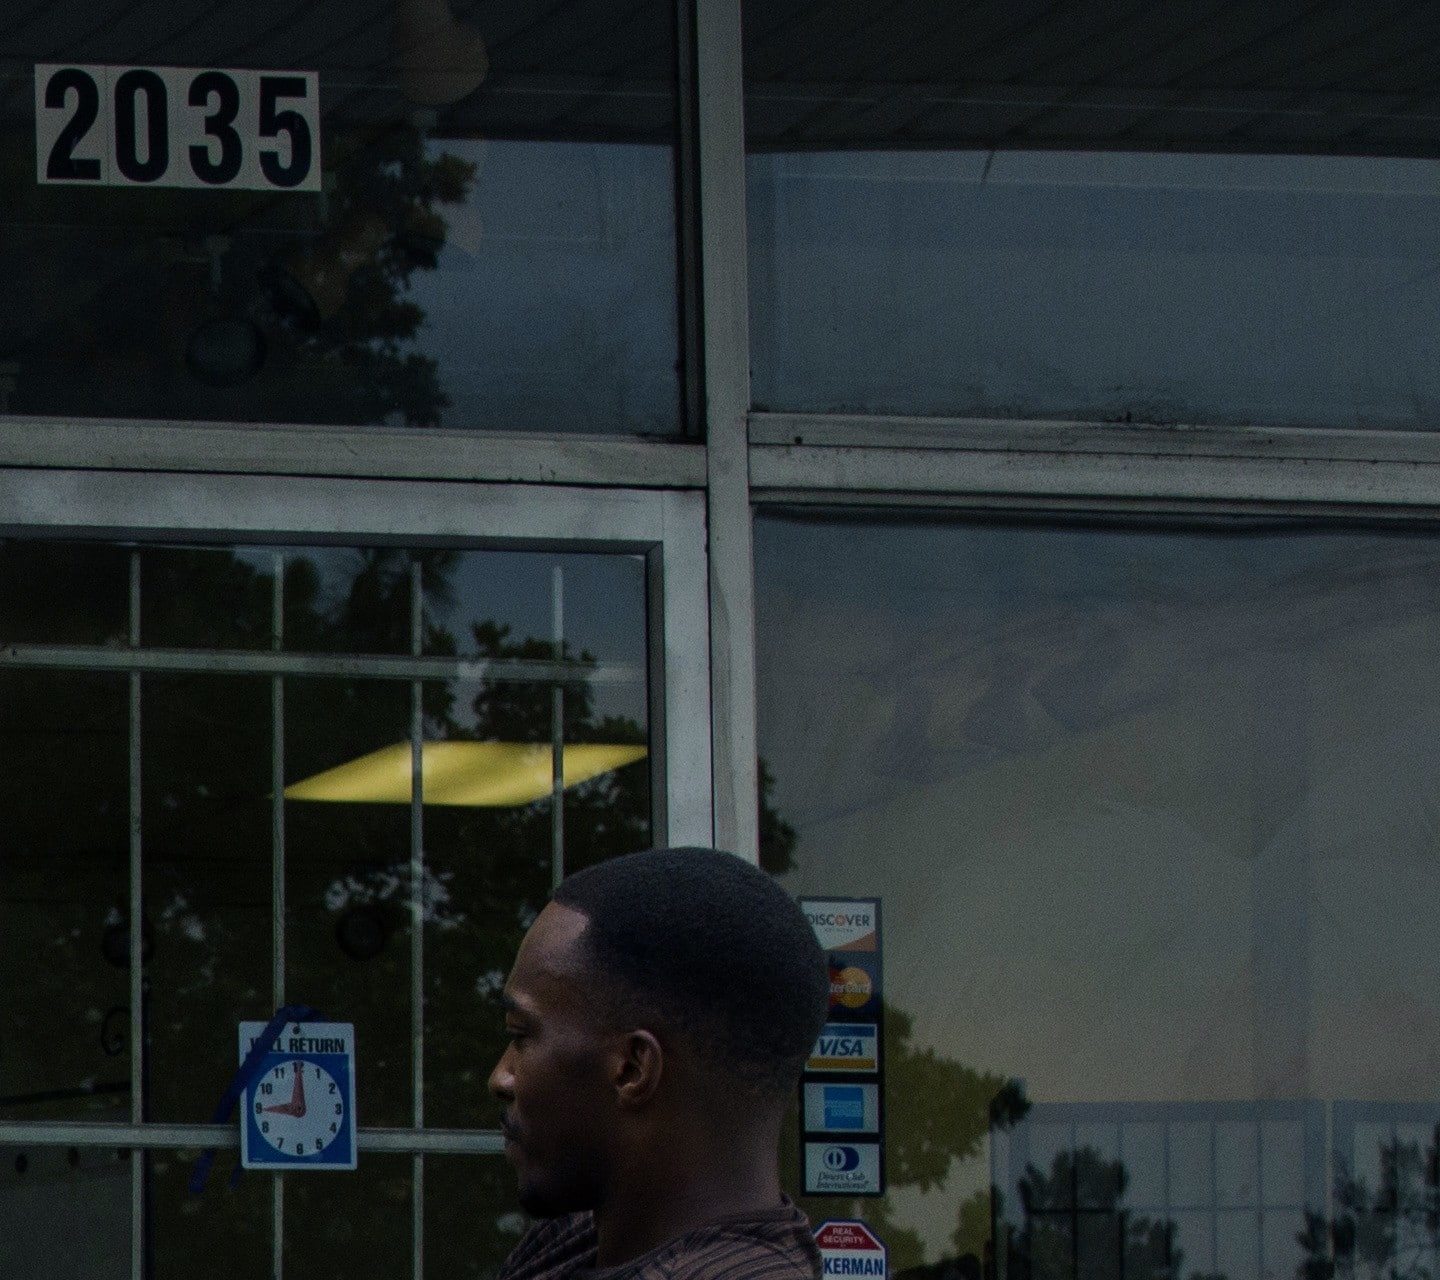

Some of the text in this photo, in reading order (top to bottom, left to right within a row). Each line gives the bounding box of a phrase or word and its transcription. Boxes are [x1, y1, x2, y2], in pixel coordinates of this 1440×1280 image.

[45, 68, 311, 187] 2035
[289, 1037, 345, 1053] RETURN
[818, 1038, 863, 1057] VISA
[274, 1067, 285, 1079] 11
[315, 1068, 321, 1080] 1
[260, 1083, 273, 1095] 10
[329, 1082, 336, 1094] 2
[255, 1102, 263, 1114] 9
[335, 1103, 342, 1115] 3
[262, 1121, 269, 1133] 8
[329, 1122, 337, 1133] 4
[277, 1137, 284, 1149] 7
[296, 1142, 304, 1155] 6
[315, 1138, 323, 1150] 5
[823, 1235, 864, 1244] SECURITY
[823, 1257, 883, 1276] KERMAN
